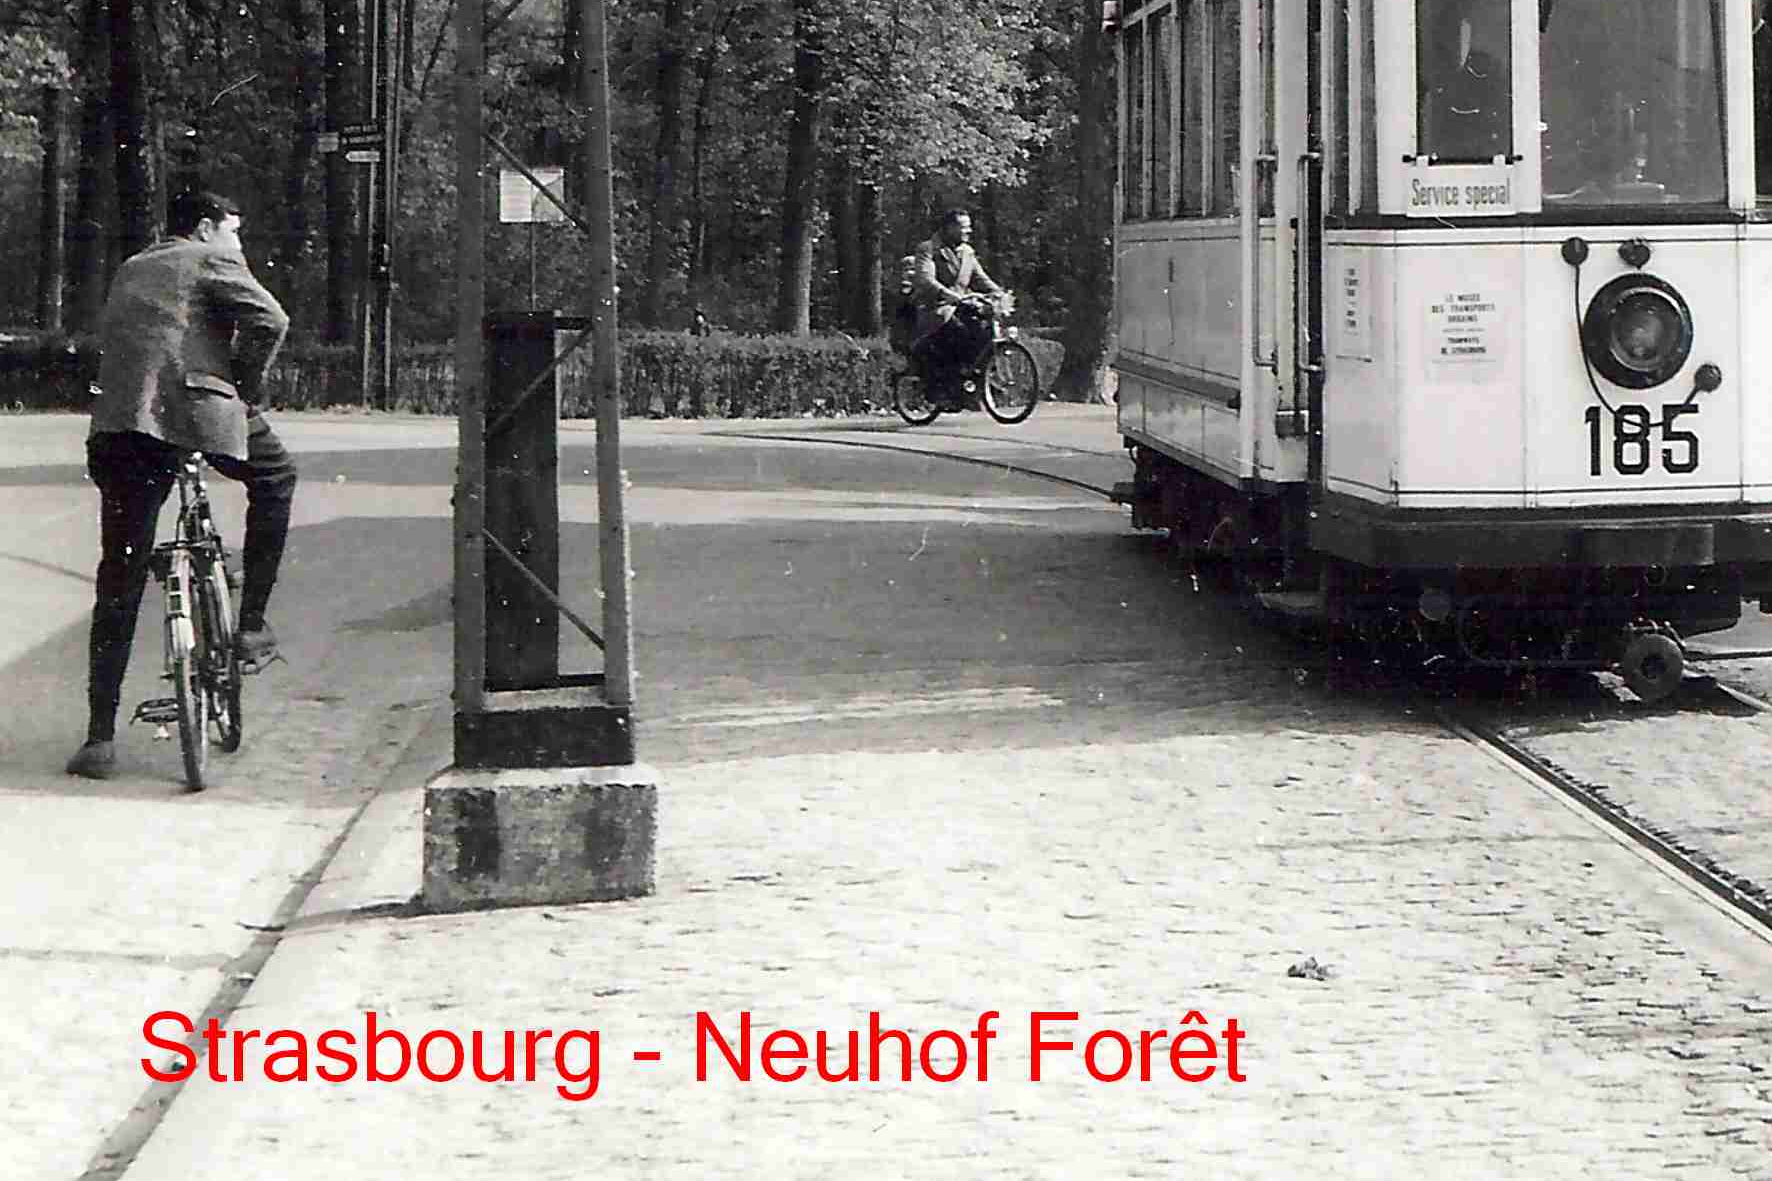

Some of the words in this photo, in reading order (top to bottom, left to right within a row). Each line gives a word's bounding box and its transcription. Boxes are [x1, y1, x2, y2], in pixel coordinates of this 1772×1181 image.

[1411, 178, 1459, 206] Service
[1465, 176, 1511, 211] special
[1585, 404, 1699, 476] 185
